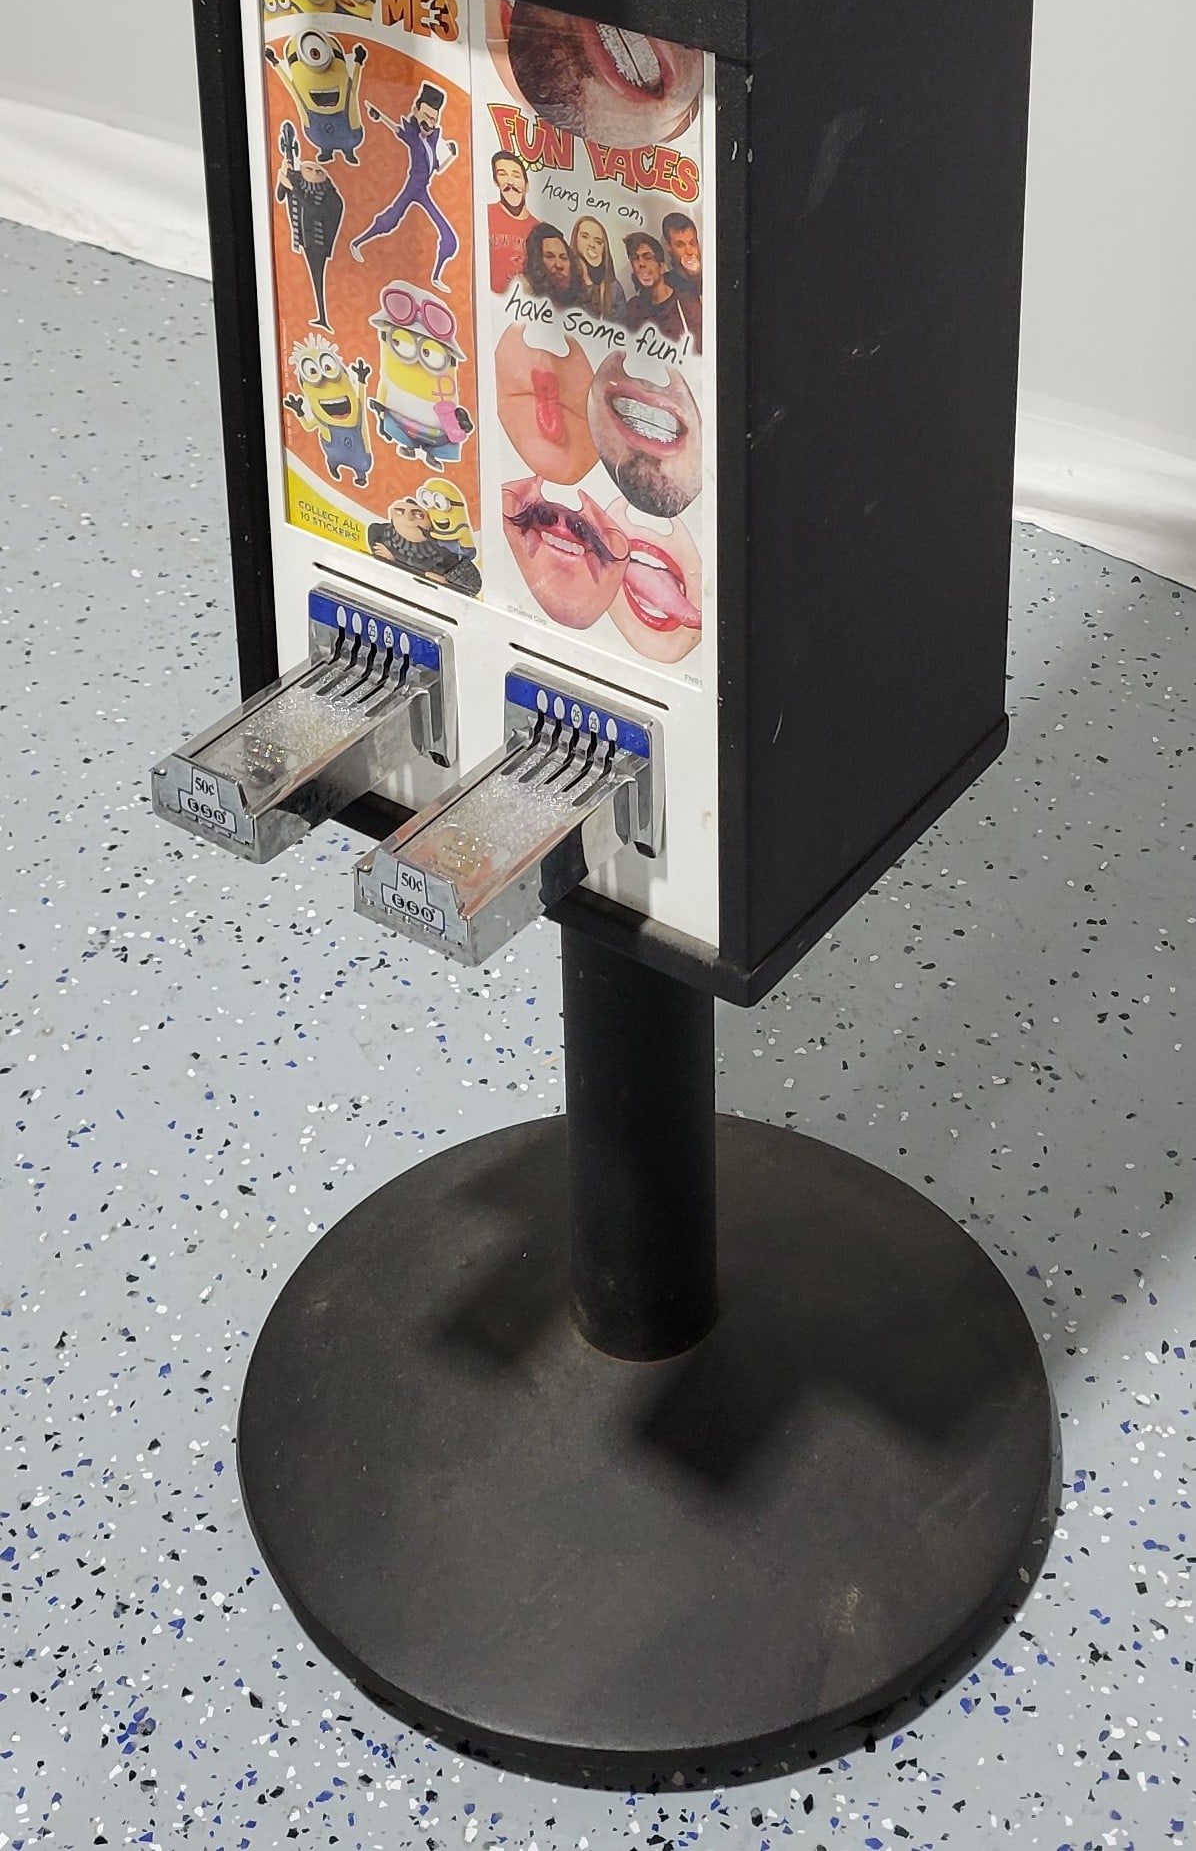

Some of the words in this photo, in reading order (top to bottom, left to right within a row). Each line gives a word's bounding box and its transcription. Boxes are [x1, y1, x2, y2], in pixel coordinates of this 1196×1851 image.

[487, 103, 575, 171] FUN
[583, 137, 700, 203] FACES
[542, 176, 579, 212] hang
[586, 189, 610, 213] 'em
[618, 206, 644, 226] on,
[505, 284, 554, 324] have
[563, 311, 626, 349] some
[636, 327, 691, 365] fun!
[298, 500, 340, 524] COLLECT
[342, 517, 362, 532] ALL
[299, 510, 310, 523] 10
[312, 517, 361, 543] STICKERS!
[195, 776, 215, 797] 50¢
[401, 872, 424, 896] 50¢
